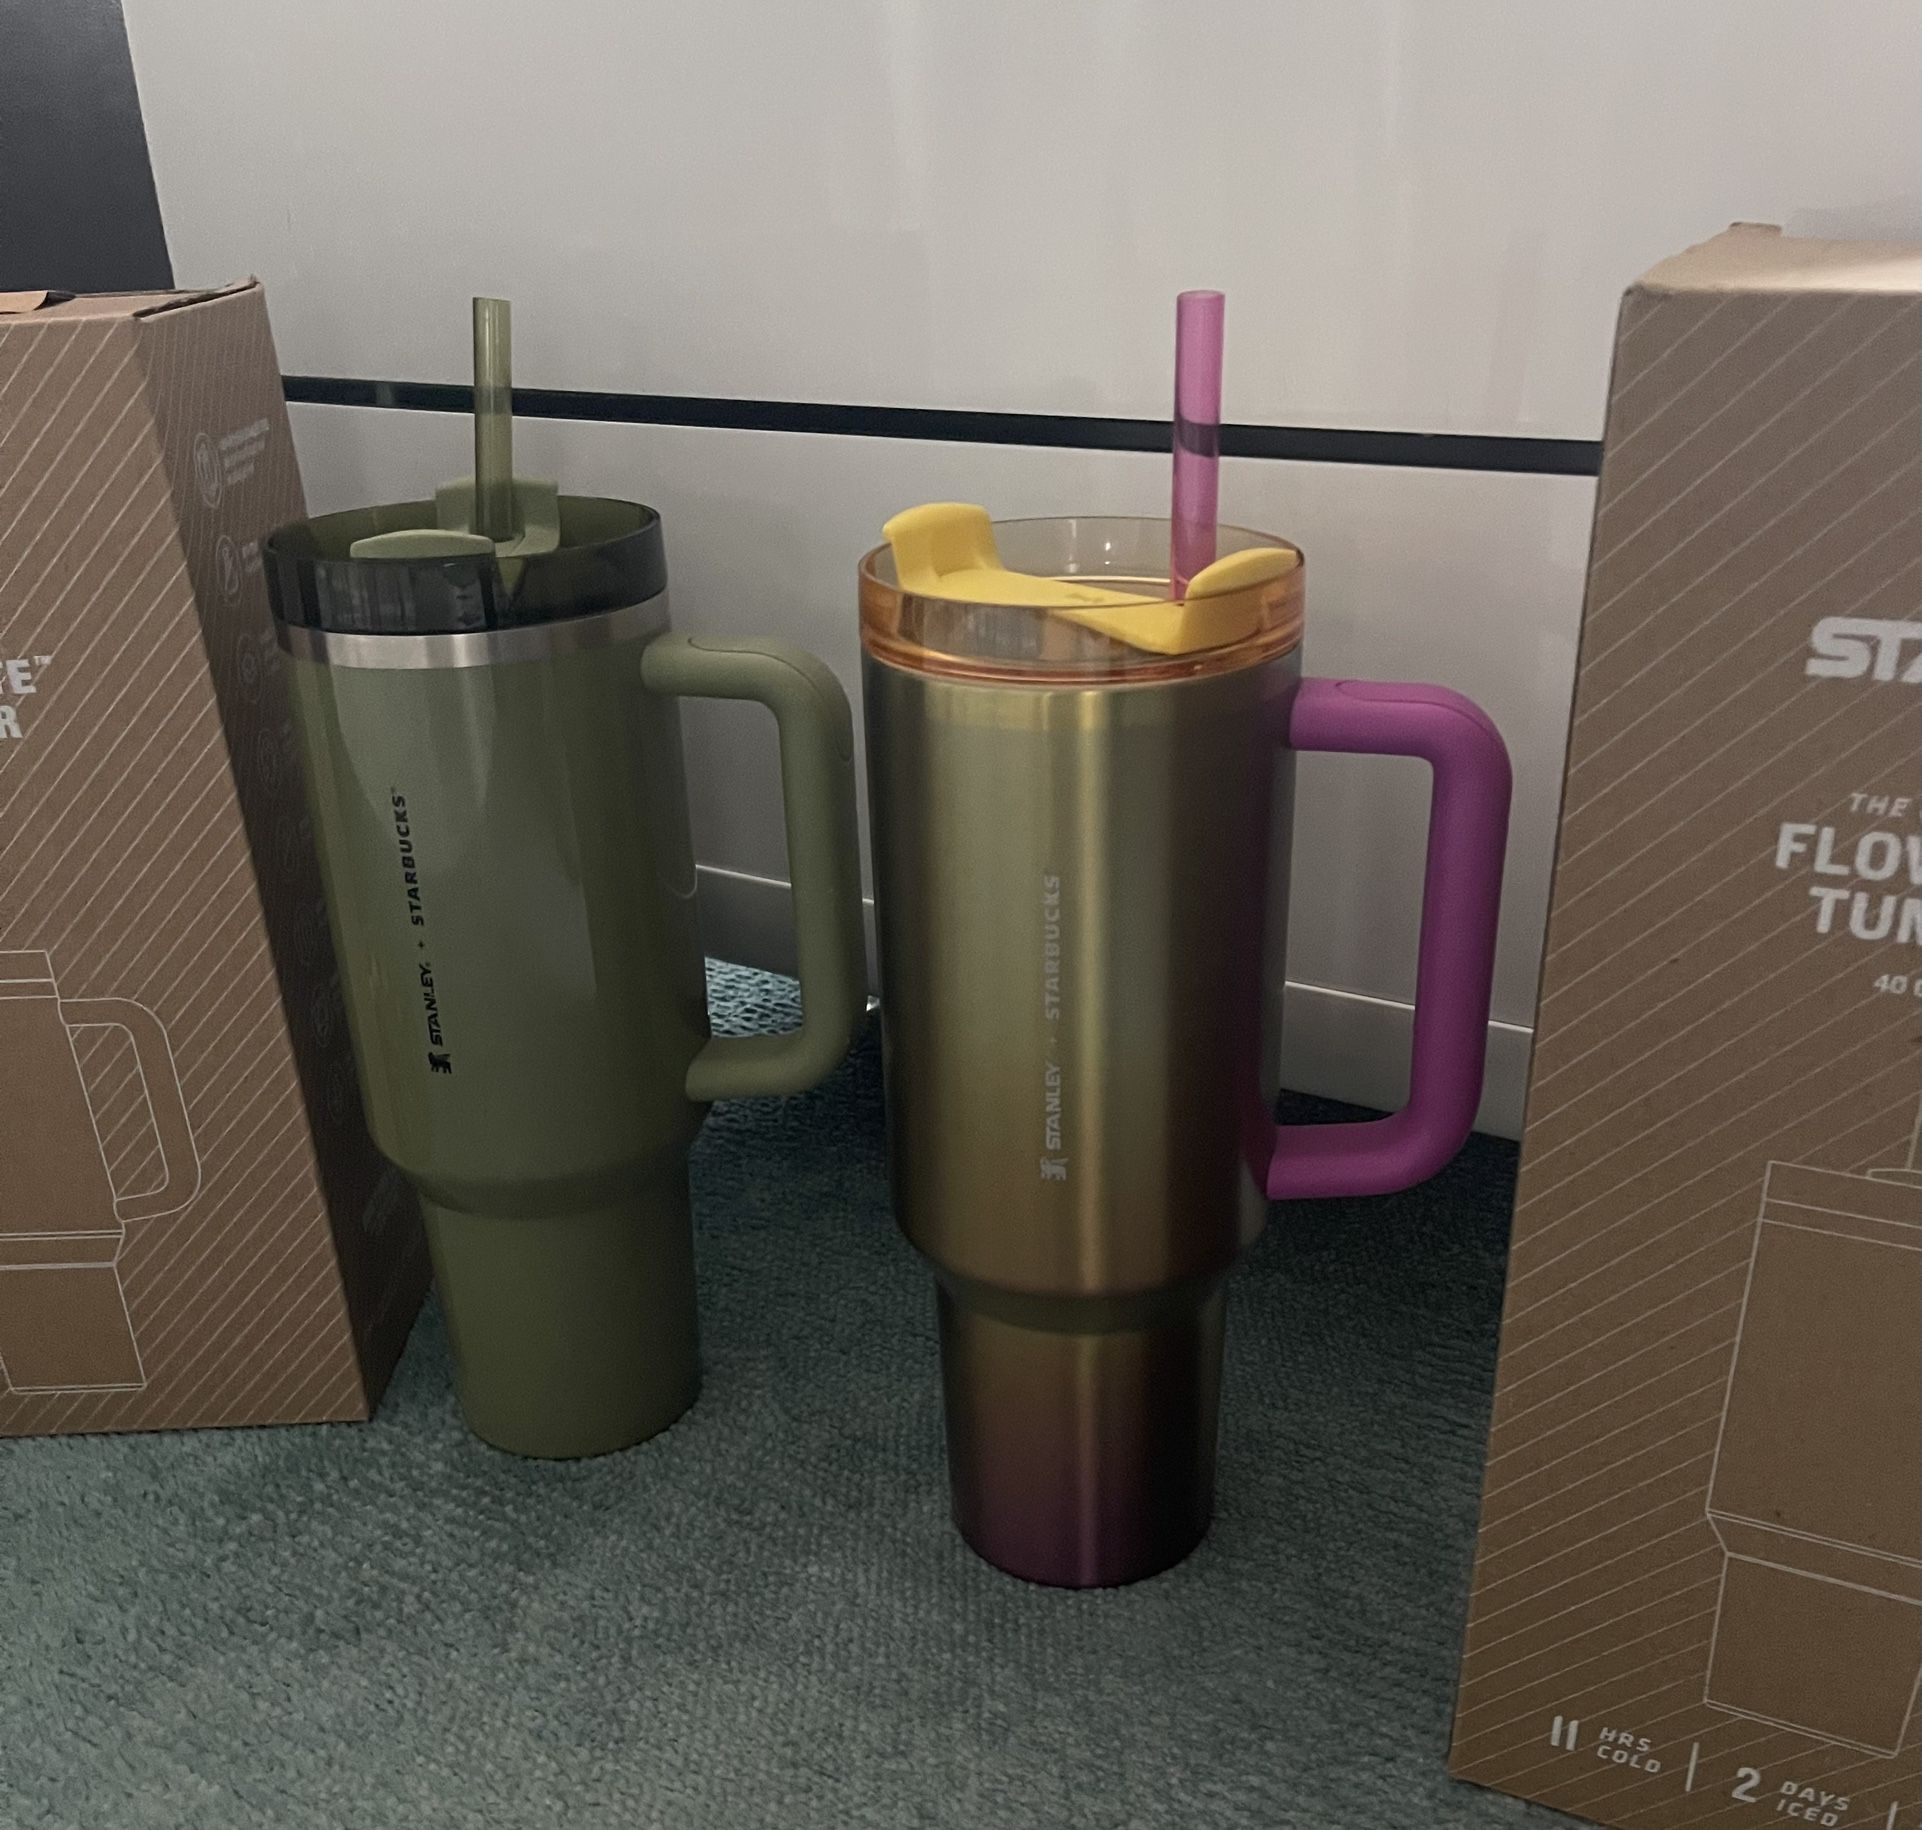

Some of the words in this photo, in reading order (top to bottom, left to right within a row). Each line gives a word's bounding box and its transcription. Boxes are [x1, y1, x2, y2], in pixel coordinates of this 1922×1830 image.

[1849, 793, 1911, 817] THE
[391, 793, 424, 926] STARBUCKS
[1044, 875, 1061, 1021] STARBUCKS
[419, 962, 442, 1047] STANLEY
[1045, 1059, 1062, 1151] STANLEY
[1599, 1727, 1651, 1752] HRS
[1597, 1745, 1661, 1773] COLD
[1731, 1767, 1761, 1803] 2
[1781, 1781, 1850, 1811] DAYS
[1776, 1799, 1839, 1827] ICED
